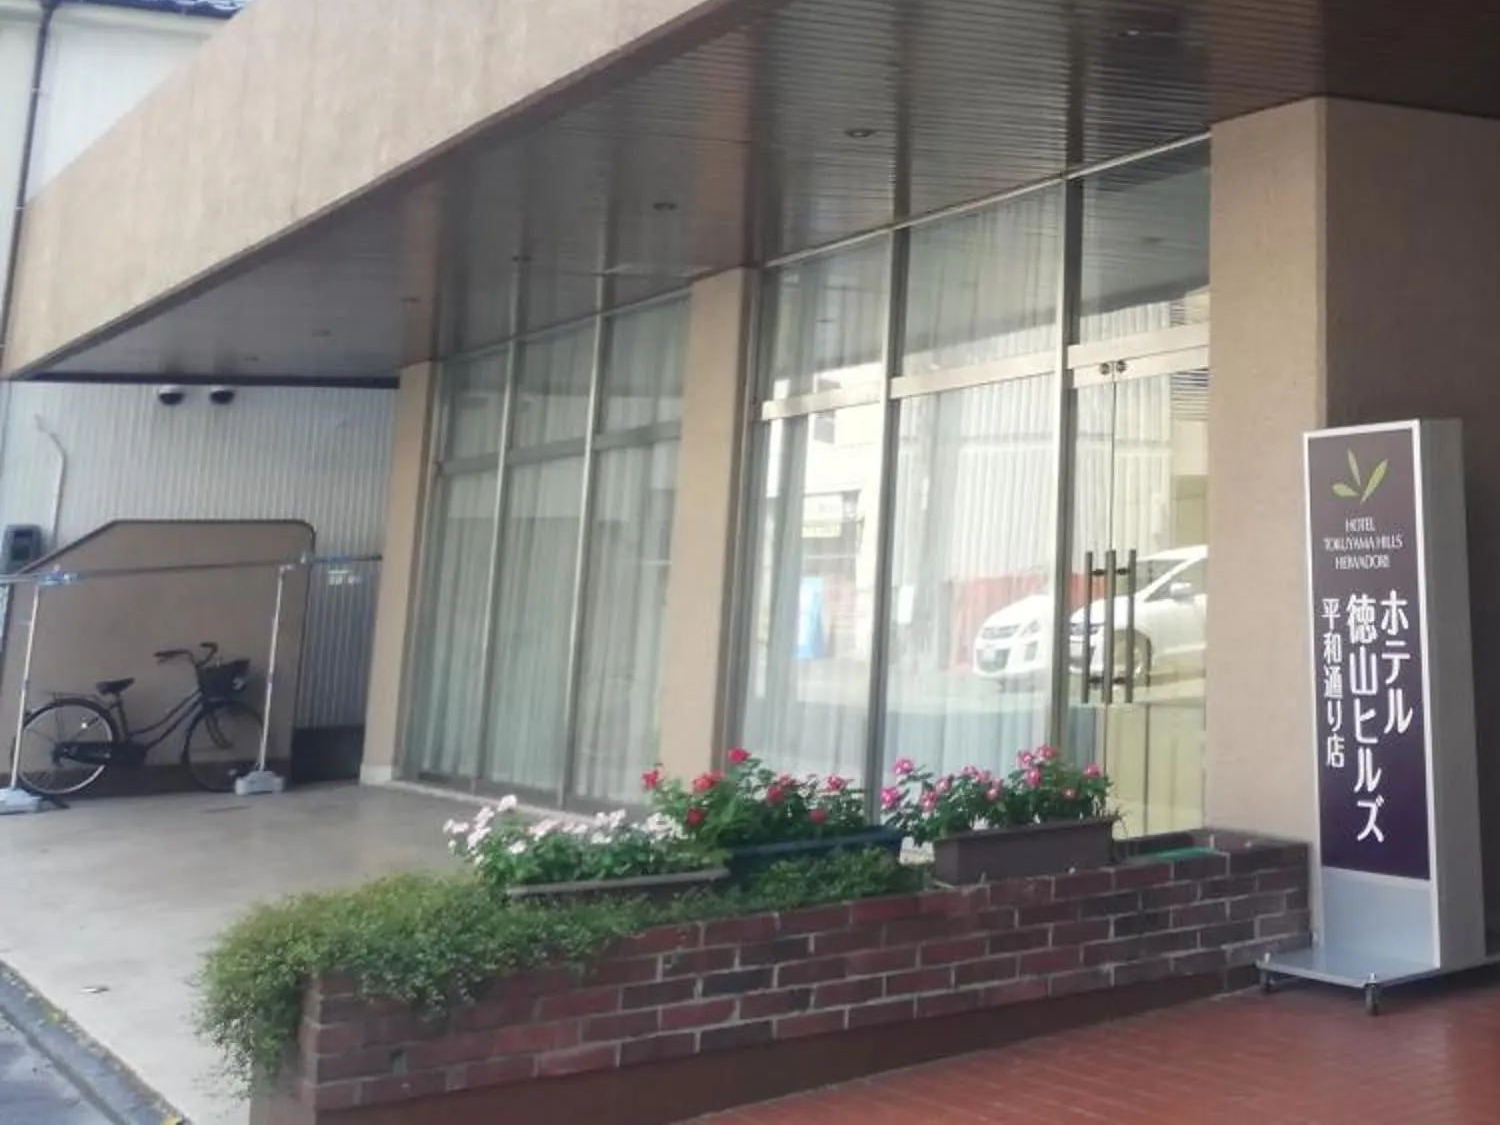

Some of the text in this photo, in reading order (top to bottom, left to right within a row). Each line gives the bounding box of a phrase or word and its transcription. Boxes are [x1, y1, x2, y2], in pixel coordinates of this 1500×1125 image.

[1323, 534, 1403, 552] TOKUYAMA HILLS
[1345, 517, 1375, 532] HOTEL
[1322, 598, 1345, 768] 平和通り店
[1346, 593, 1385, 843] 徳山ヒルズ
[1381, 589, 1413, 734] ホテル
